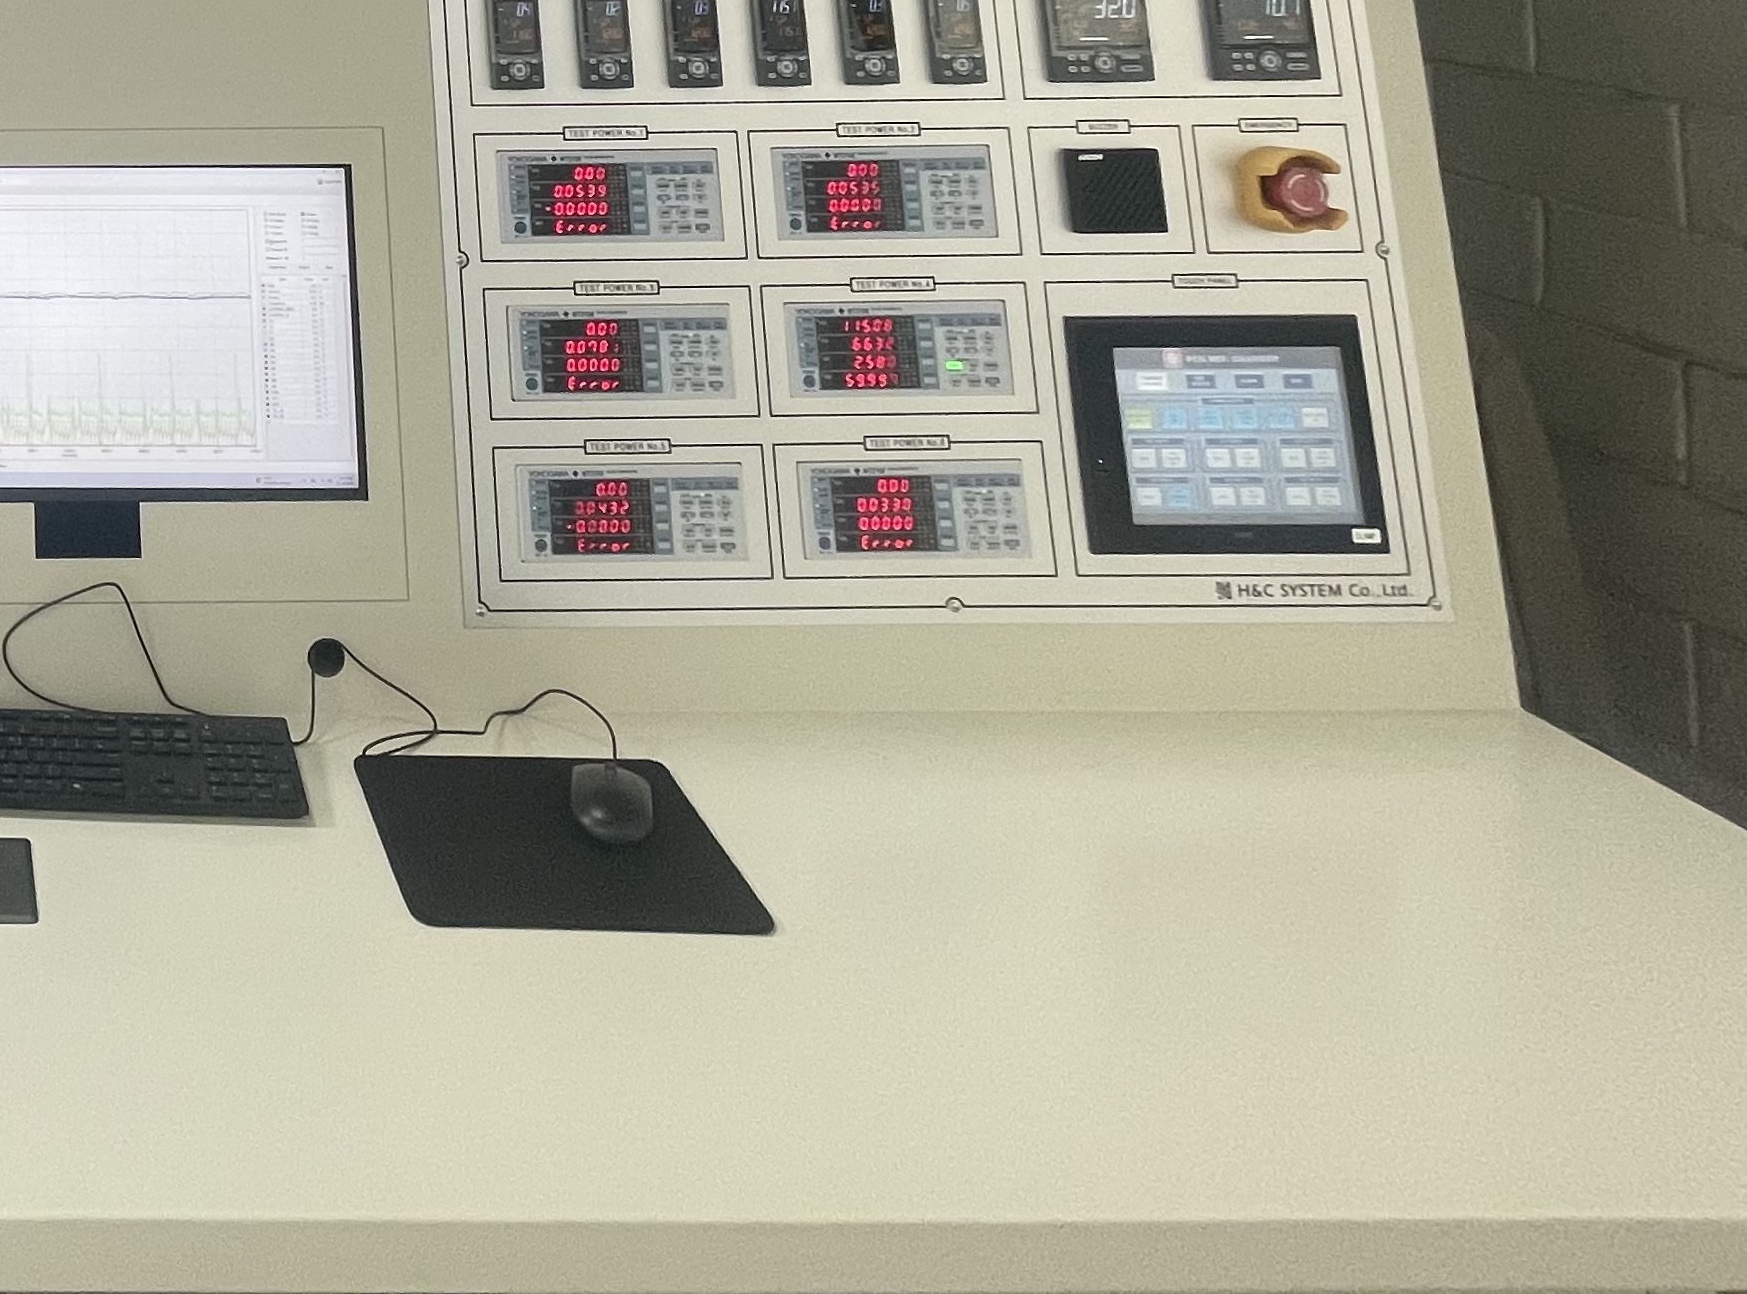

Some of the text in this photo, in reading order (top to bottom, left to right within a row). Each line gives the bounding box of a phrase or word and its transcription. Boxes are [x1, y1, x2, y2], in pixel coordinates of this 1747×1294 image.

[842, 126, 862, 134] TEST
[579, 284, 600, 292] TEST
[589, 443, 610, 451] TEST
[869, 439, 890, 447] TEST
[893, 439, 924, 447] POWER
[1237, 583, 1275, 598] H&C
[1280, 583, 1342, 598] SYSTEM
